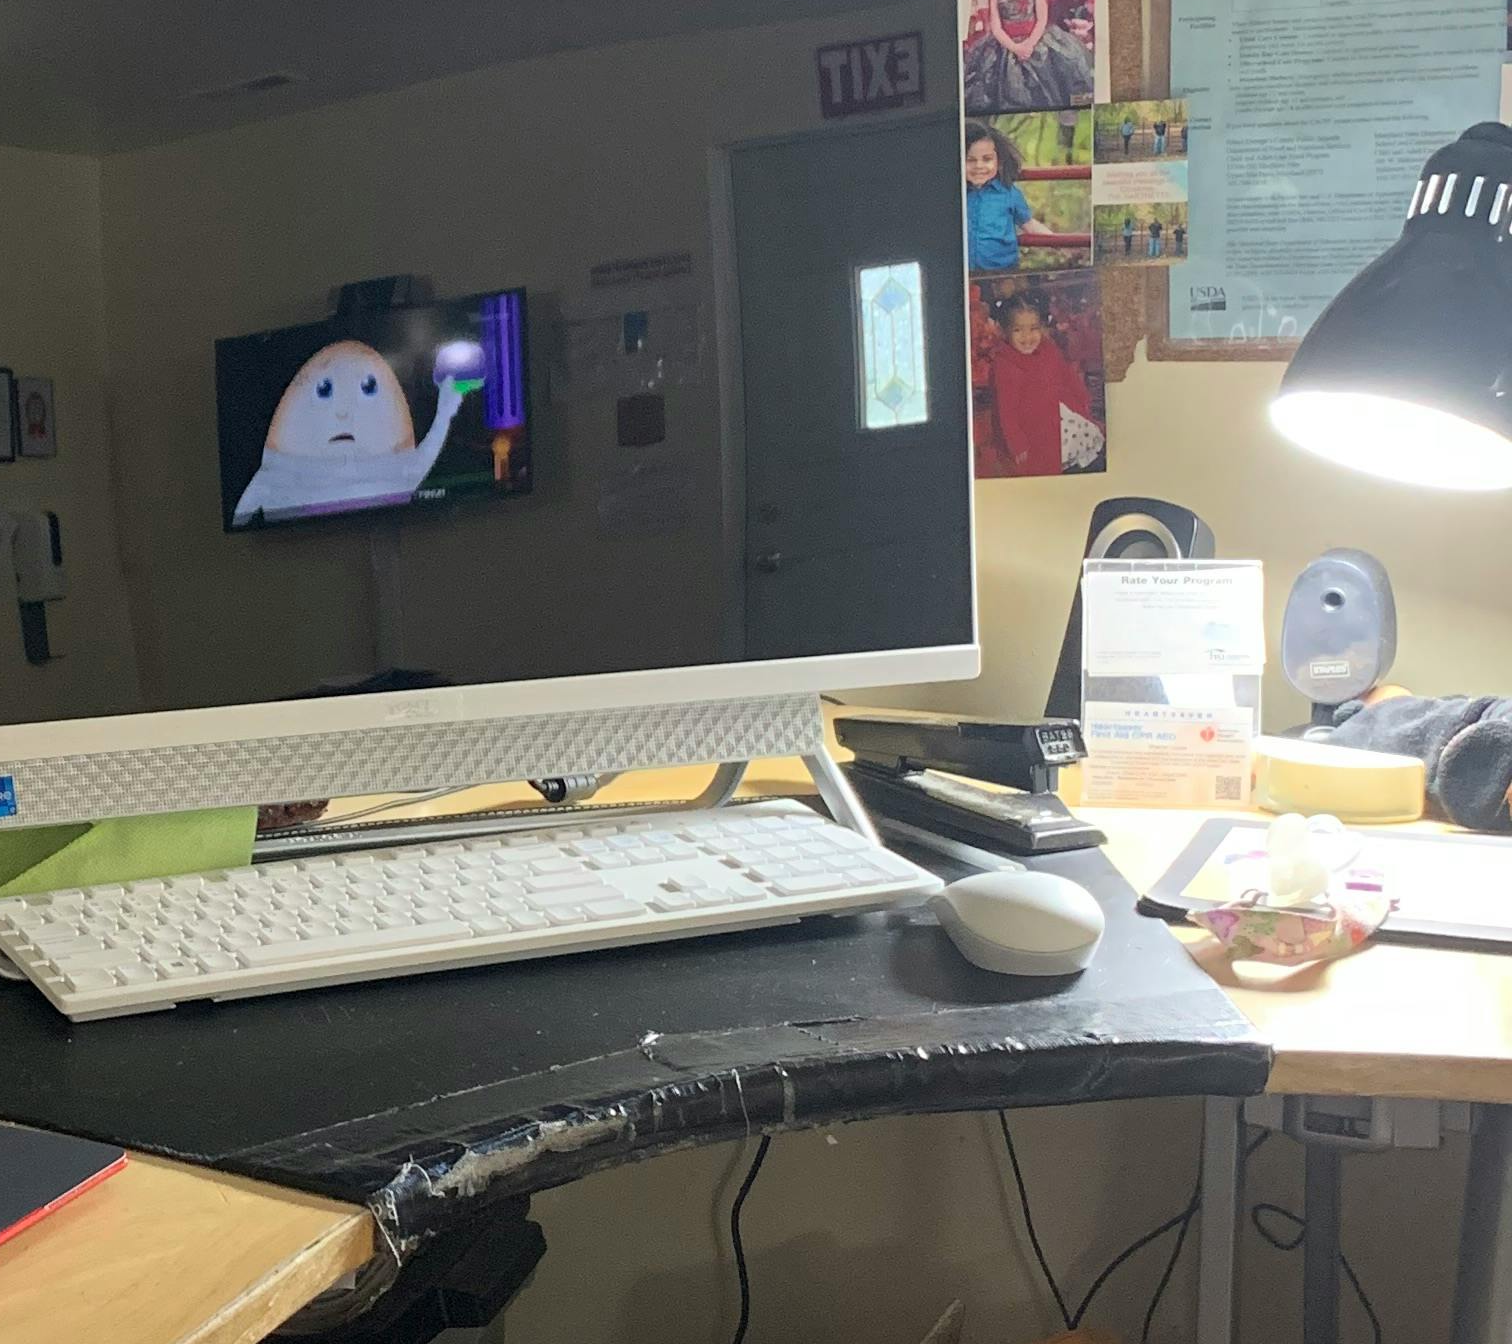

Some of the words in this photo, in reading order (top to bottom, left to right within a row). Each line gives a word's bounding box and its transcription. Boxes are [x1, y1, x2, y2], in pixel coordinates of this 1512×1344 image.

[1190, 286, 1227, 298] USDA
[1121, 575, 1148, 585] Rate
[1151, 575, 1179, 585] Your
[1183, 575, 1234, 586] Program
